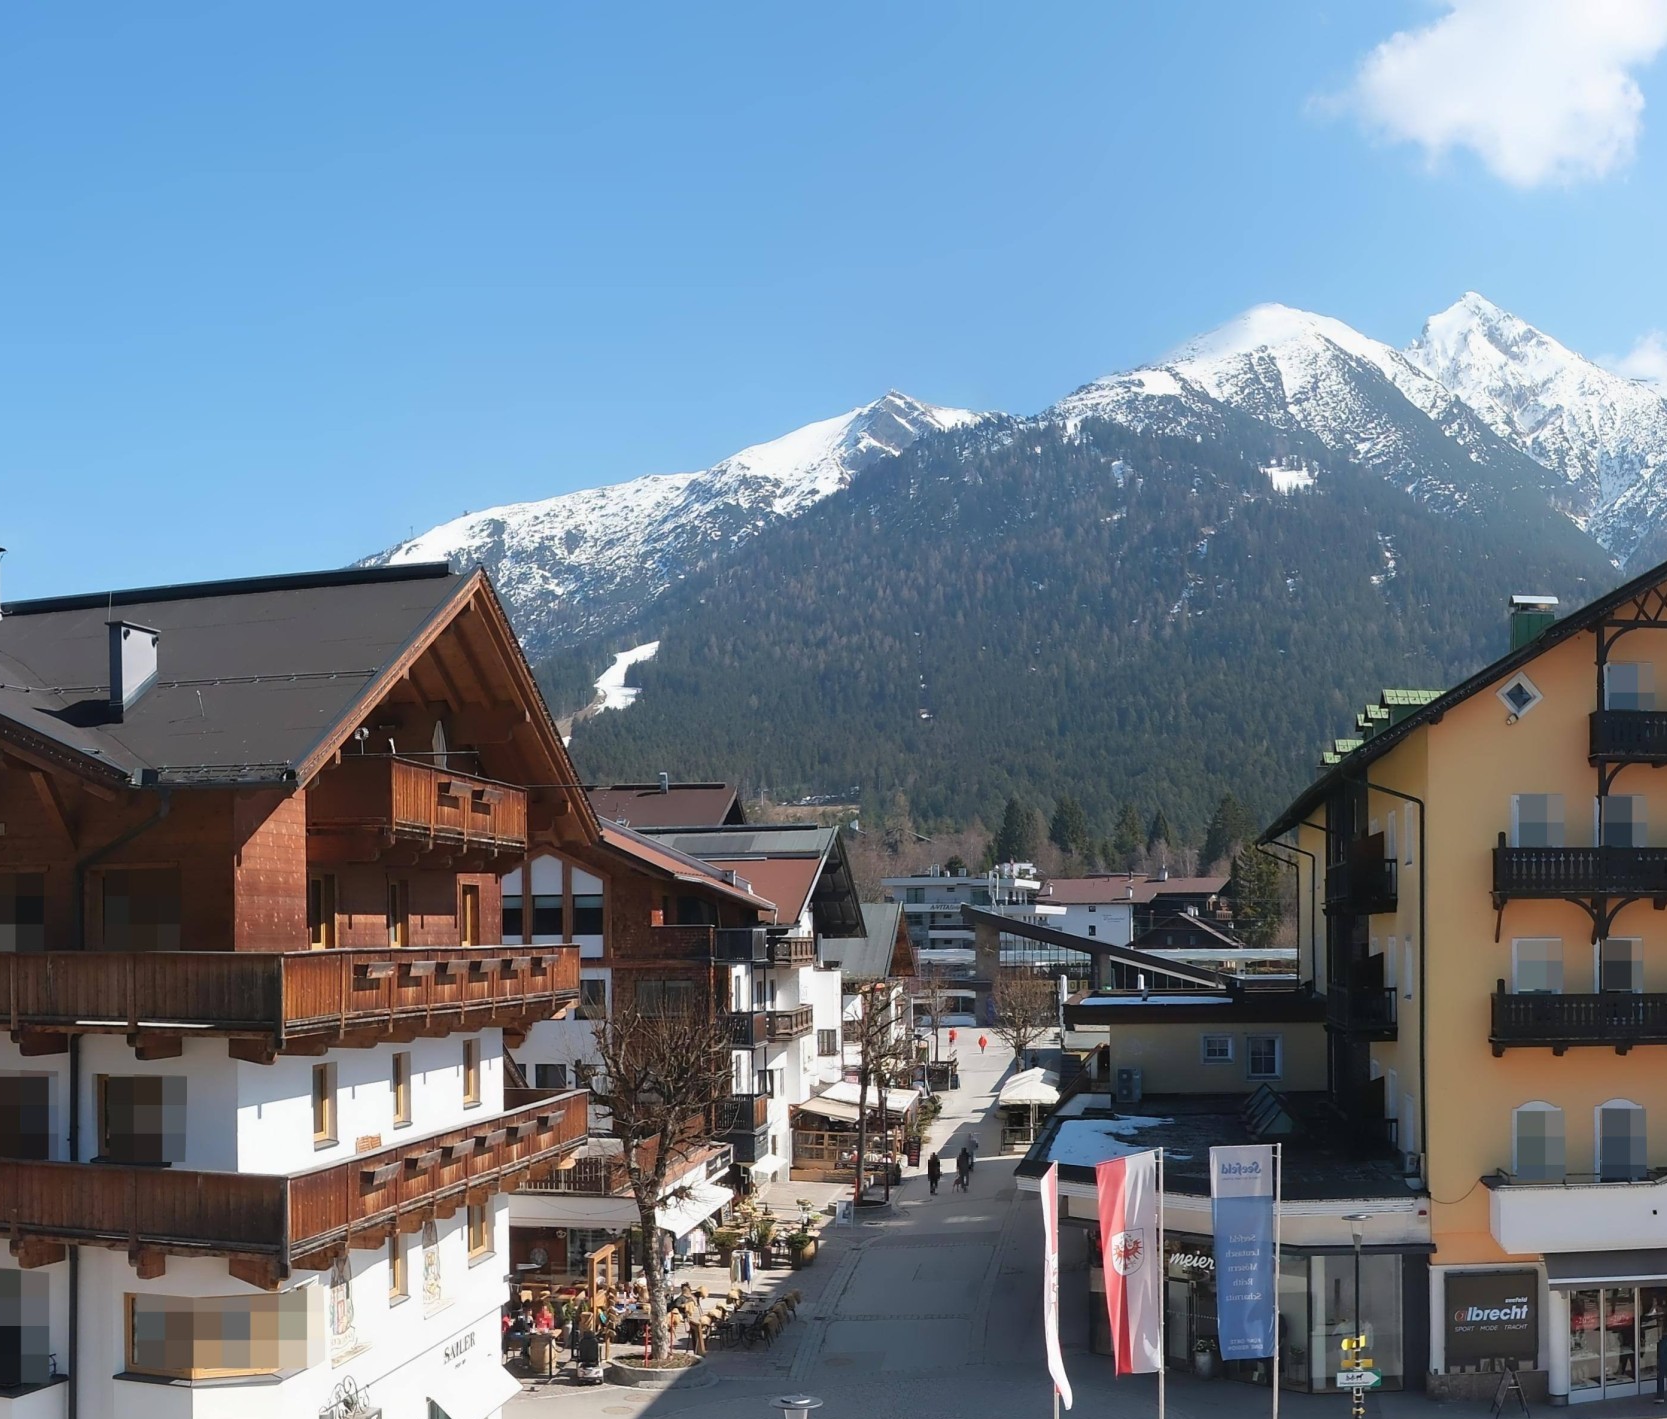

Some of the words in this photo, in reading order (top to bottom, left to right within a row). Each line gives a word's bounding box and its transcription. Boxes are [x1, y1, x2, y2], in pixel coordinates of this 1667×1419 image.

[1169, 1250, 1215, 1270] meier
[1504, 1323, 1528, 1331] TRACHT
[444, 1331, 476, 1365] SAILER
